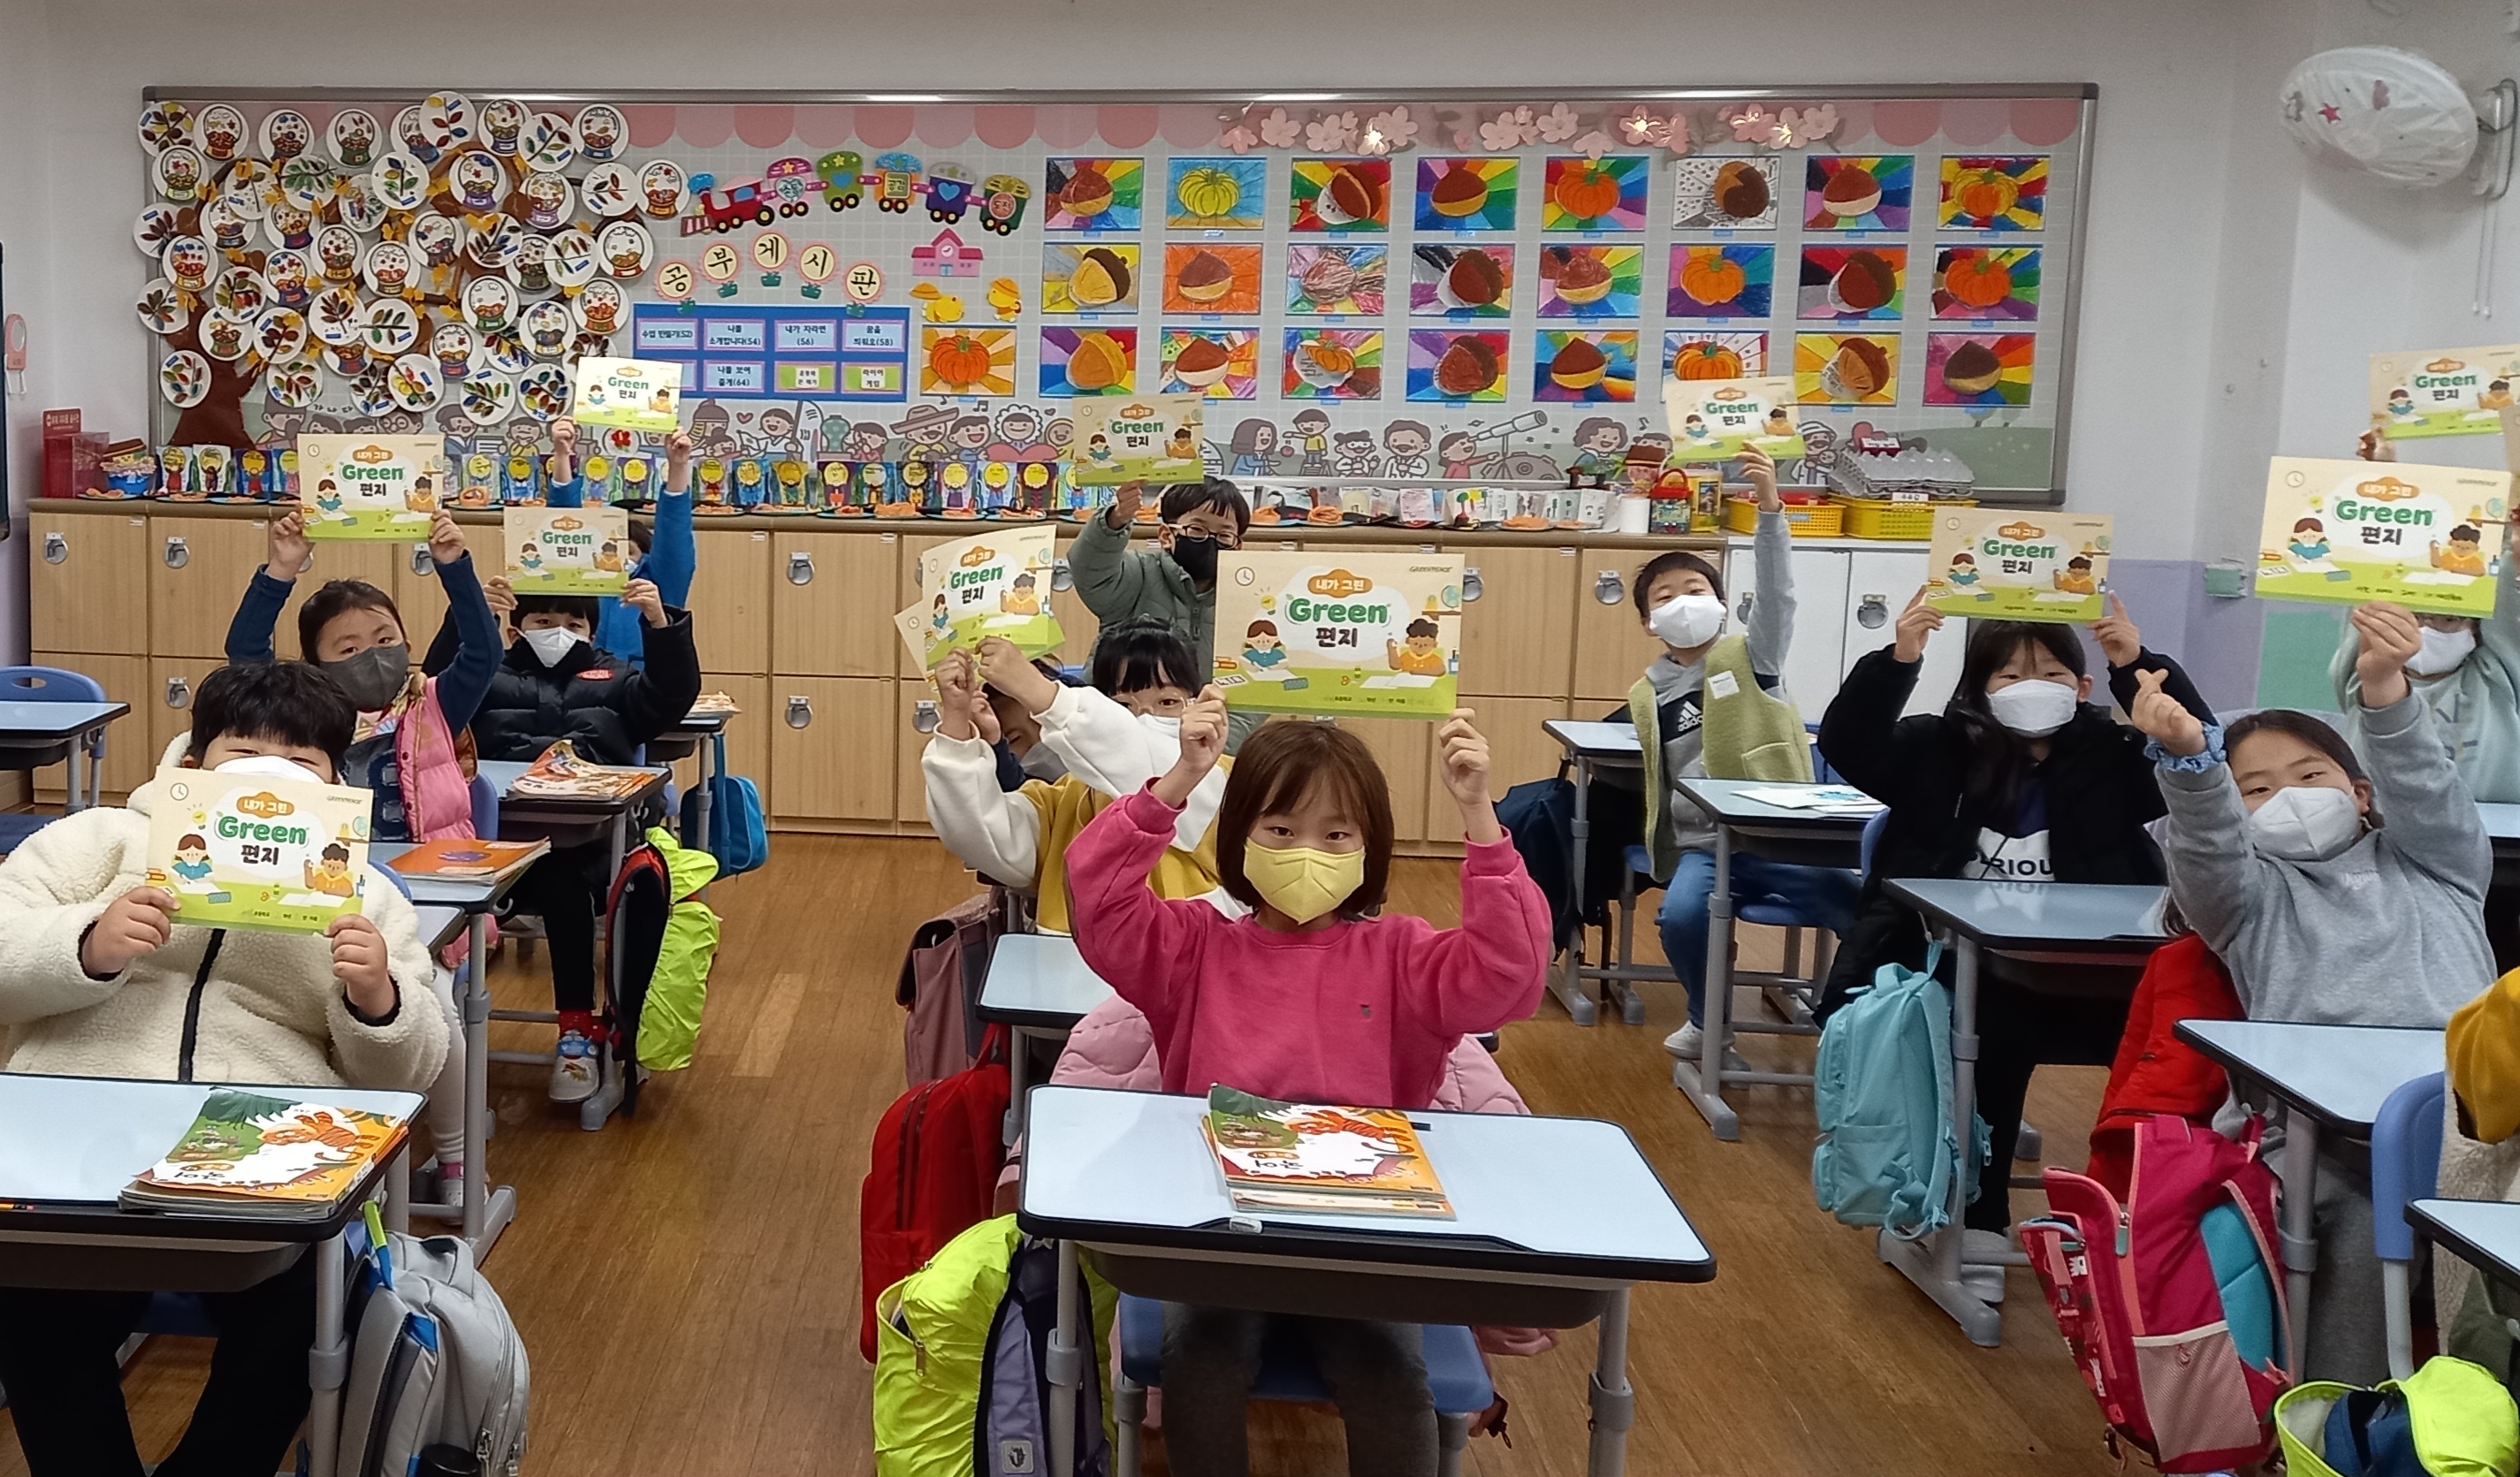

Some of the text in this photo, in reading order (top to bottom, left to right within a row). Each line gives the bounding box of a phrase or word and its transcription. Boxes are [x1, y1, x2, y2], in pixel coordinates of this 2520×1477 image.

[785, 325, 826, 334] 내가 자라면
[866, 325, 882, 334] 꿈을
[796, 338, 814, 346] (56)
[608, 377, 649, 390] Green
[2415, 375, 2477, 388] Green
[1706, 402, 1759, 414] Green
[1111, 421, 1164, 434] Green
[1126, 436, 1149, 447] 편지
[342, 464, 404, 480] Green
[360, 483, 386, 497] 편지
[2336, 500, 2432, 526] Green
[542, 531, 591, 544] Green
[2361, 527, 2402, 546] 편지
[556, 546, 578, 558] 편지
[1983, 539, 2056, 559] Green
[2002, 560, 2033, 575] 편지
[951, 566, 1003, 590] Green
[1316, 578, 1365, 591] 내가 그린
[962, 586, 985, 605] 편지
[1289, 598, 1388, 623] Green
[1316, 627, 1358, 648] 편지
[244, 799, 288, 813] 내가 그린
[218, 815, 307, 844] Green
[241, 844, 279, 865] 편지
[1989, 857, 2052, 877] RIOU
